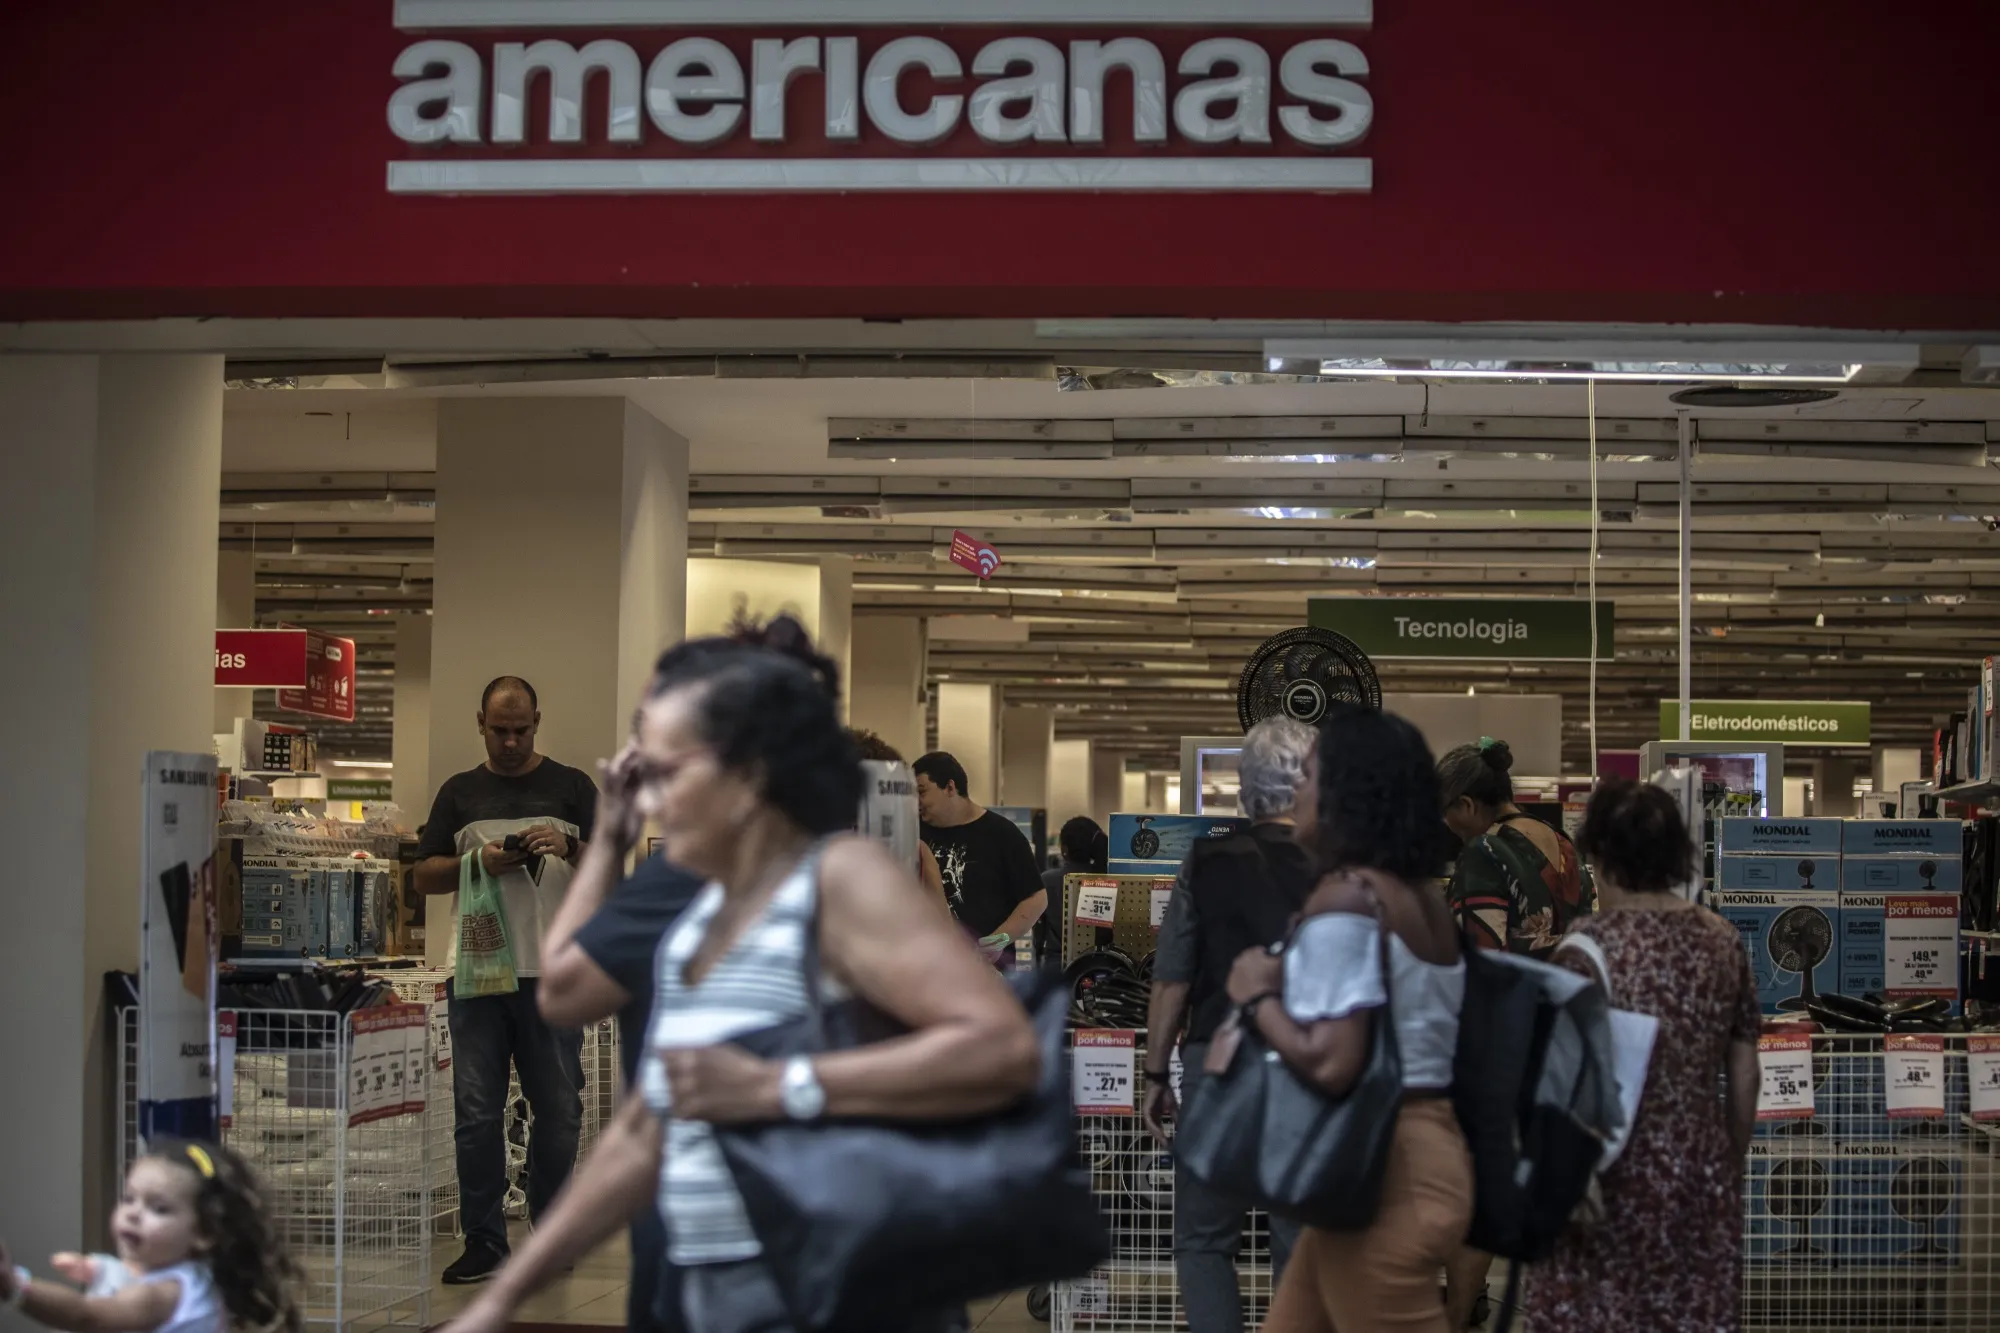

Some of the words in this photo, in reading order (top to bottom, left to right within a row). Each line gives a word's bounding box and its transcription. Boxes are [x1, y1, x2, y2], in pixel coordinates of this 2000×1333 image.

[386, 35, 1374, 145] americanas
[1394, 616, 1528, 644] Tecnologia
[1691, 714, 1839, 732] Eletrodomésticos
[1752, 825, 1812, 836] MONDIAL
[1874, 828, 1933, 839] MONDIAL
[1722, 895, 1776, 904] MONDIAL
[1844, 897, 1884, 907] MONDI
[1889, 907, 1909, 917] por
[1912, 907, 1953, 915] menos
[1077, 1037, 1094, 1046] por
[1097, 1037, 1132, 1045] menos
[1759, 1041, 1771, 1050] or
[1773, 1041, 1808, 1049] menos
[1887, 1041, 1904, 1051] por
[1906, 1041, 1941, 1050] menos
[1844, 1146, 1899, 1155] MONDIAL
